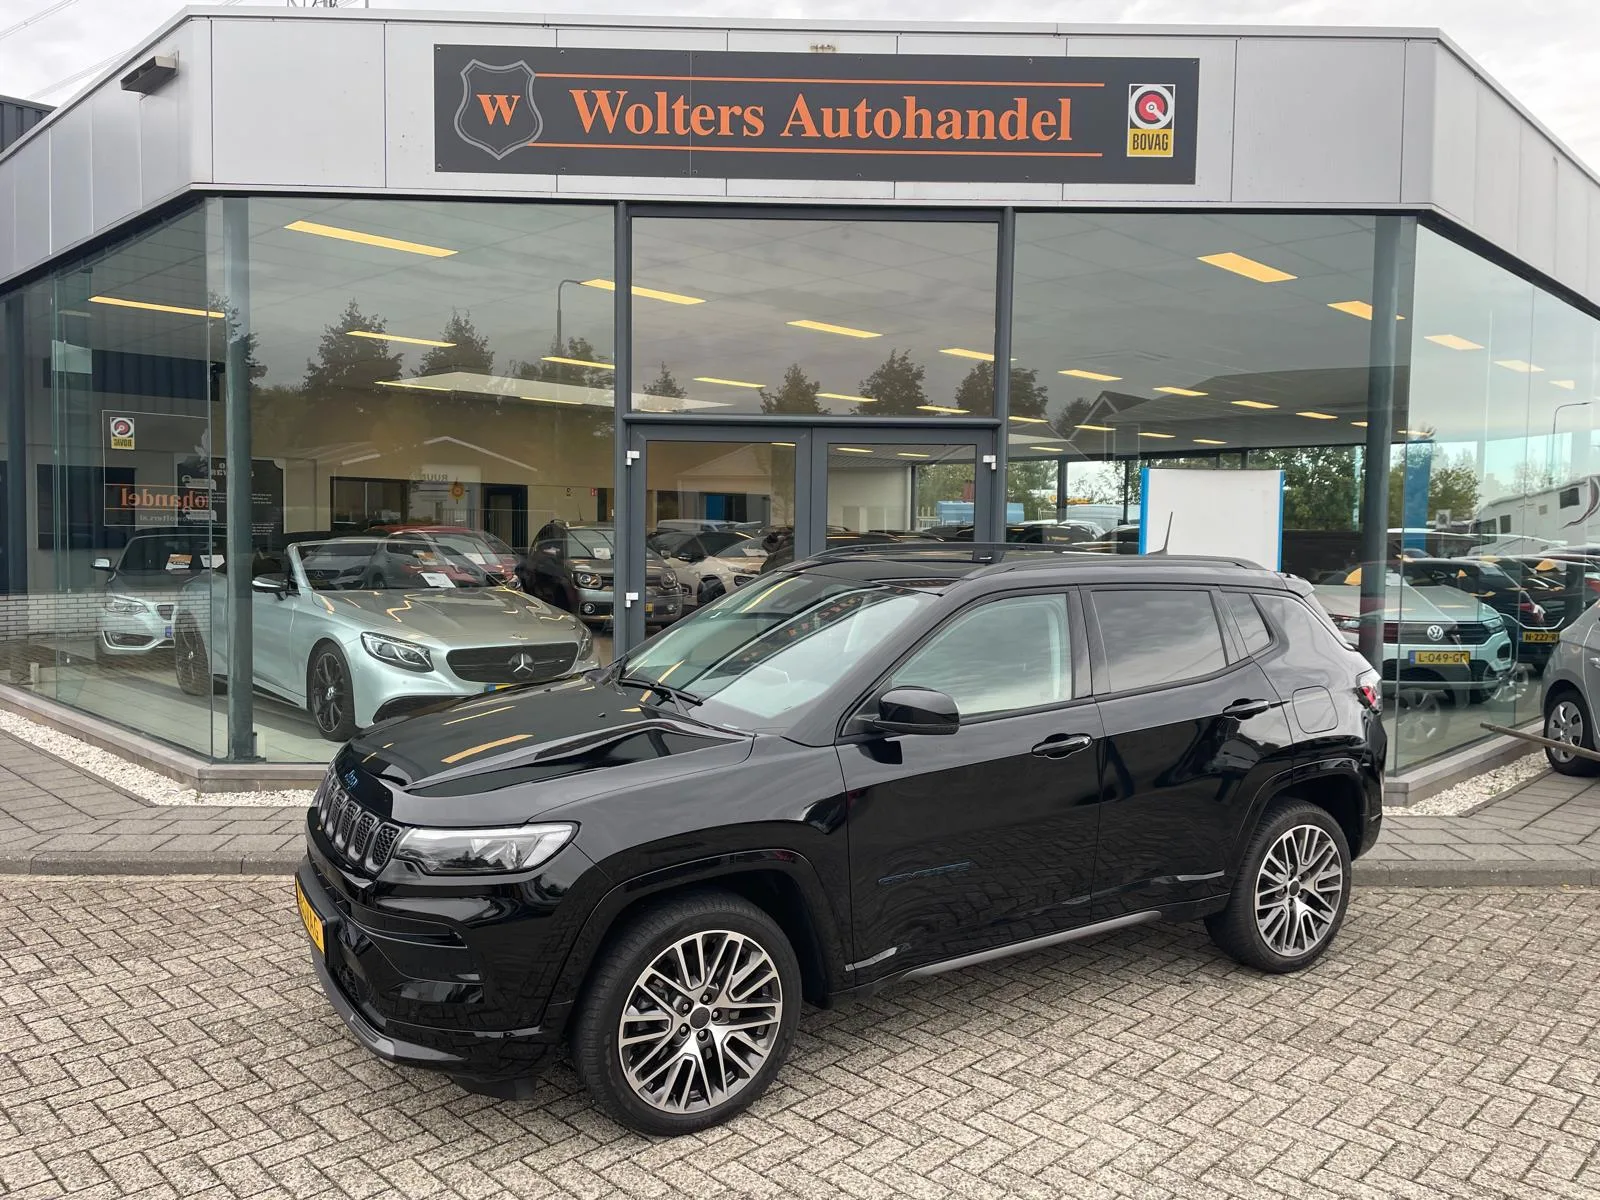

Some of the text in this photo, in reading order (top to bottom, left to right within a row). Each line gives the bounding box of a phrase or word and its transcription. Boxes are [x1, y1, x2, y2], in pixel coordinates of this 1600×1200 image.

[476, 94, 520, 125] W
[569, 89, 1072, 141] Wolters Autohandel
[1132, 133, 1169, 151] BOVAG
